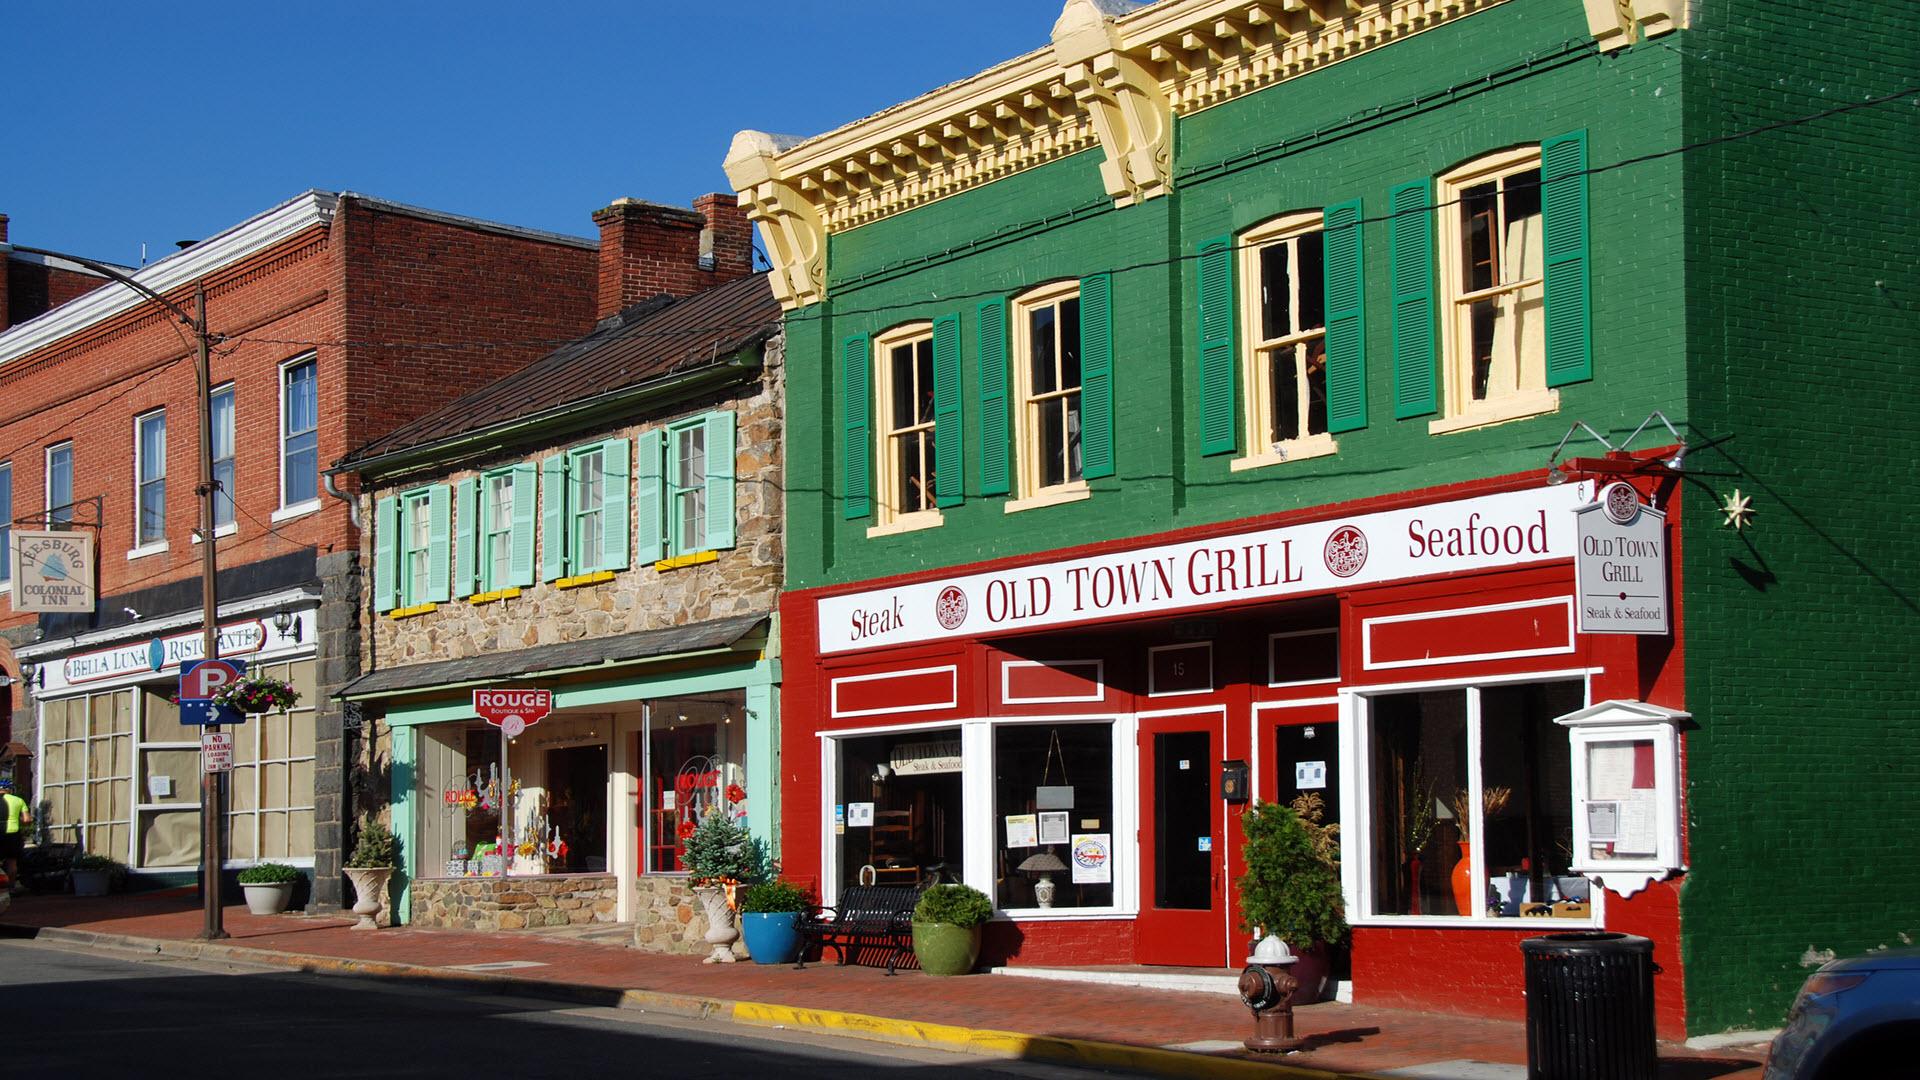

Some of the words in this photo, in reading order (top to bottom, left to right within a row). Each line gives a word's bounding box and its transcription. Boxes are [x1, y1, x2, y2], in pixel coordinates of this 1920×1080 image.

[1408, 510, 1549, 558] Seafood
[22, 540, 84, 568] LEESBURG
[1583, 535, 1613, 556] OLD
[1616, 536, 1658, 558] TOWN
[986, 576, 1051, 623] OLD
[1066, 557, 1175, 611] TOWN
[1187, 539, 1303, 596] GRILL
[1602, 561, 1643, 583] GRILL
[24, 585, 85, 596] COLONIAL
[41, 595, 68, 606] INN
[851, 596, 904, 641] Steak
[1586, 606, 1611, 619] Steak
[1613, 607, 1622, 619] &
[1624, 606, 1661, 620] Seafood
[73, 656, 109, 677] BELLA
[113, 649, 147, 670] LUNA
[200, 669, 227, 696] P
[479, 693, 547, 707] ROUGE
[205, 743, 231, 751] PARKING
[445, 789, 477, 803] ROUGE
